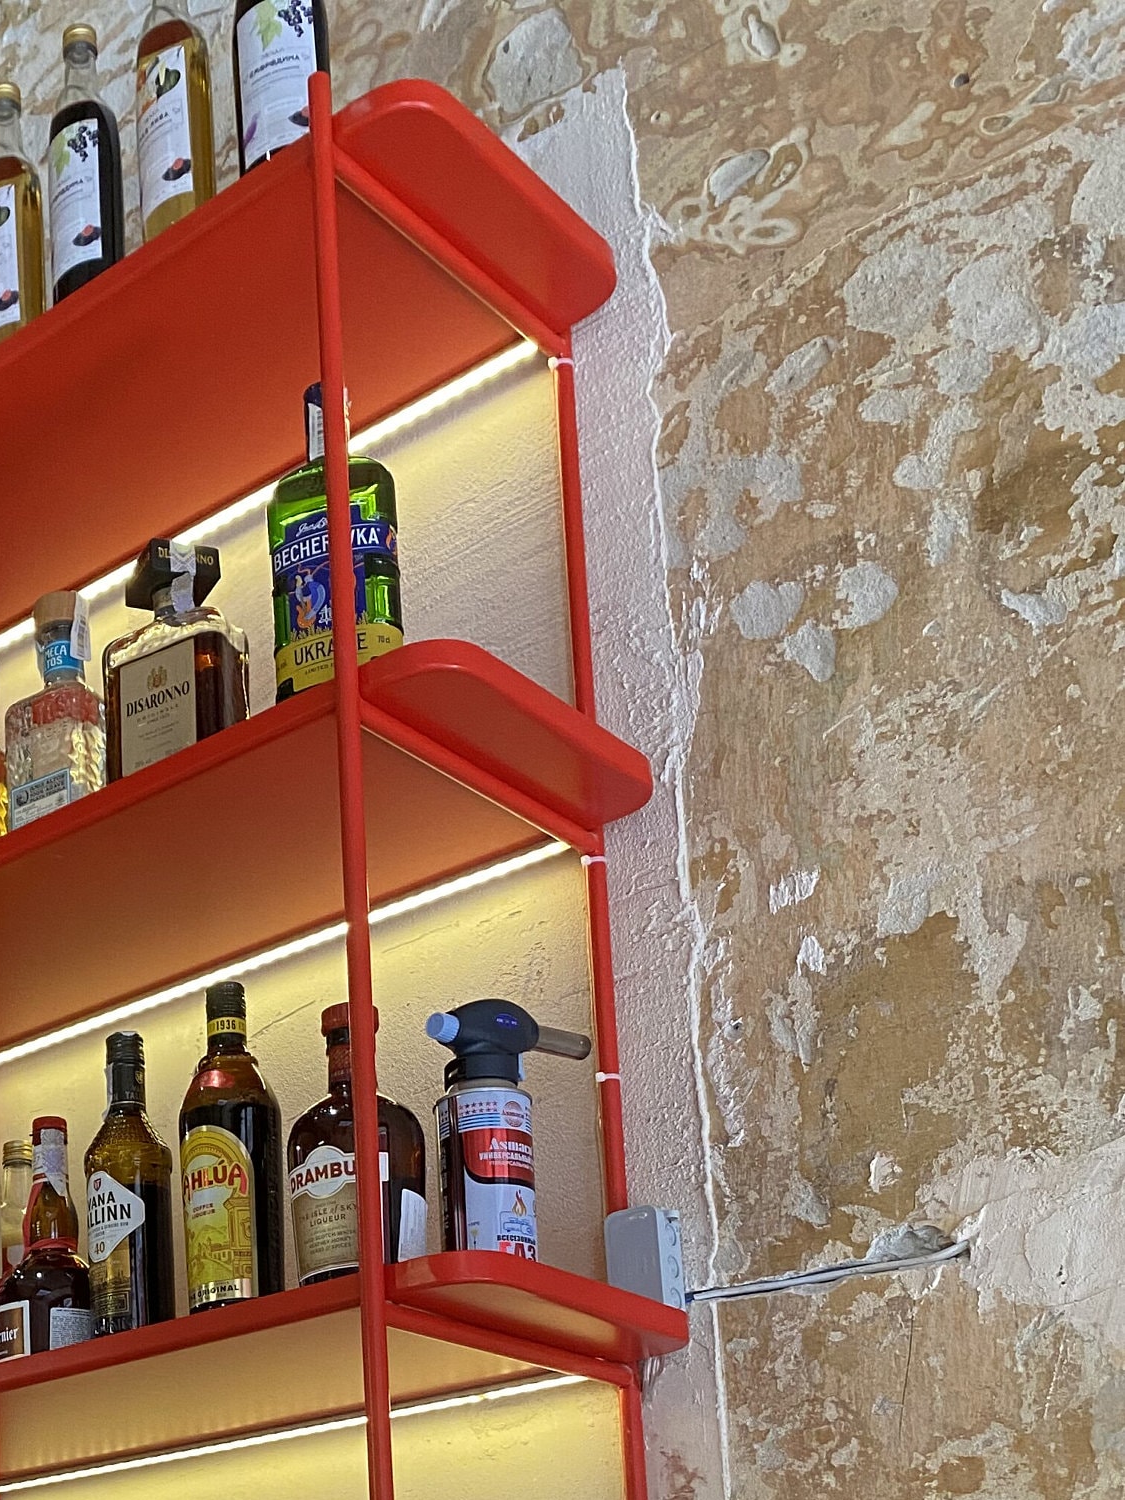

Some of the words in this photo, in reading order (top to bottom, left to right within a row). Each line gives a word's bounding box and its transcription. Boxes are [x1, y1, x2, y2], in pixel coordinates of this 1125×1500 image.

[274, 527, 380, 572] BECHERKA
[294, 632, 368, 666] UKRAE
[126, 680, 191, 717] DISARONNO
[216, 1019, 236, 1031] 1936
[183, 1160, 248, 1202] AHLÚA
[290, 1160, 356, 1195] DRAMBU
[88, 1203, 132, 1228] LLINN
[310, 1214, 346, 1228] LIQUEUR
[311, 1208, 328, 1219] ISLE
[340, 1203, 357, 1212] SKY
[94, 1241, 105, 1255] 40
[198, 1284, 240, 1299] ORIGINAL
